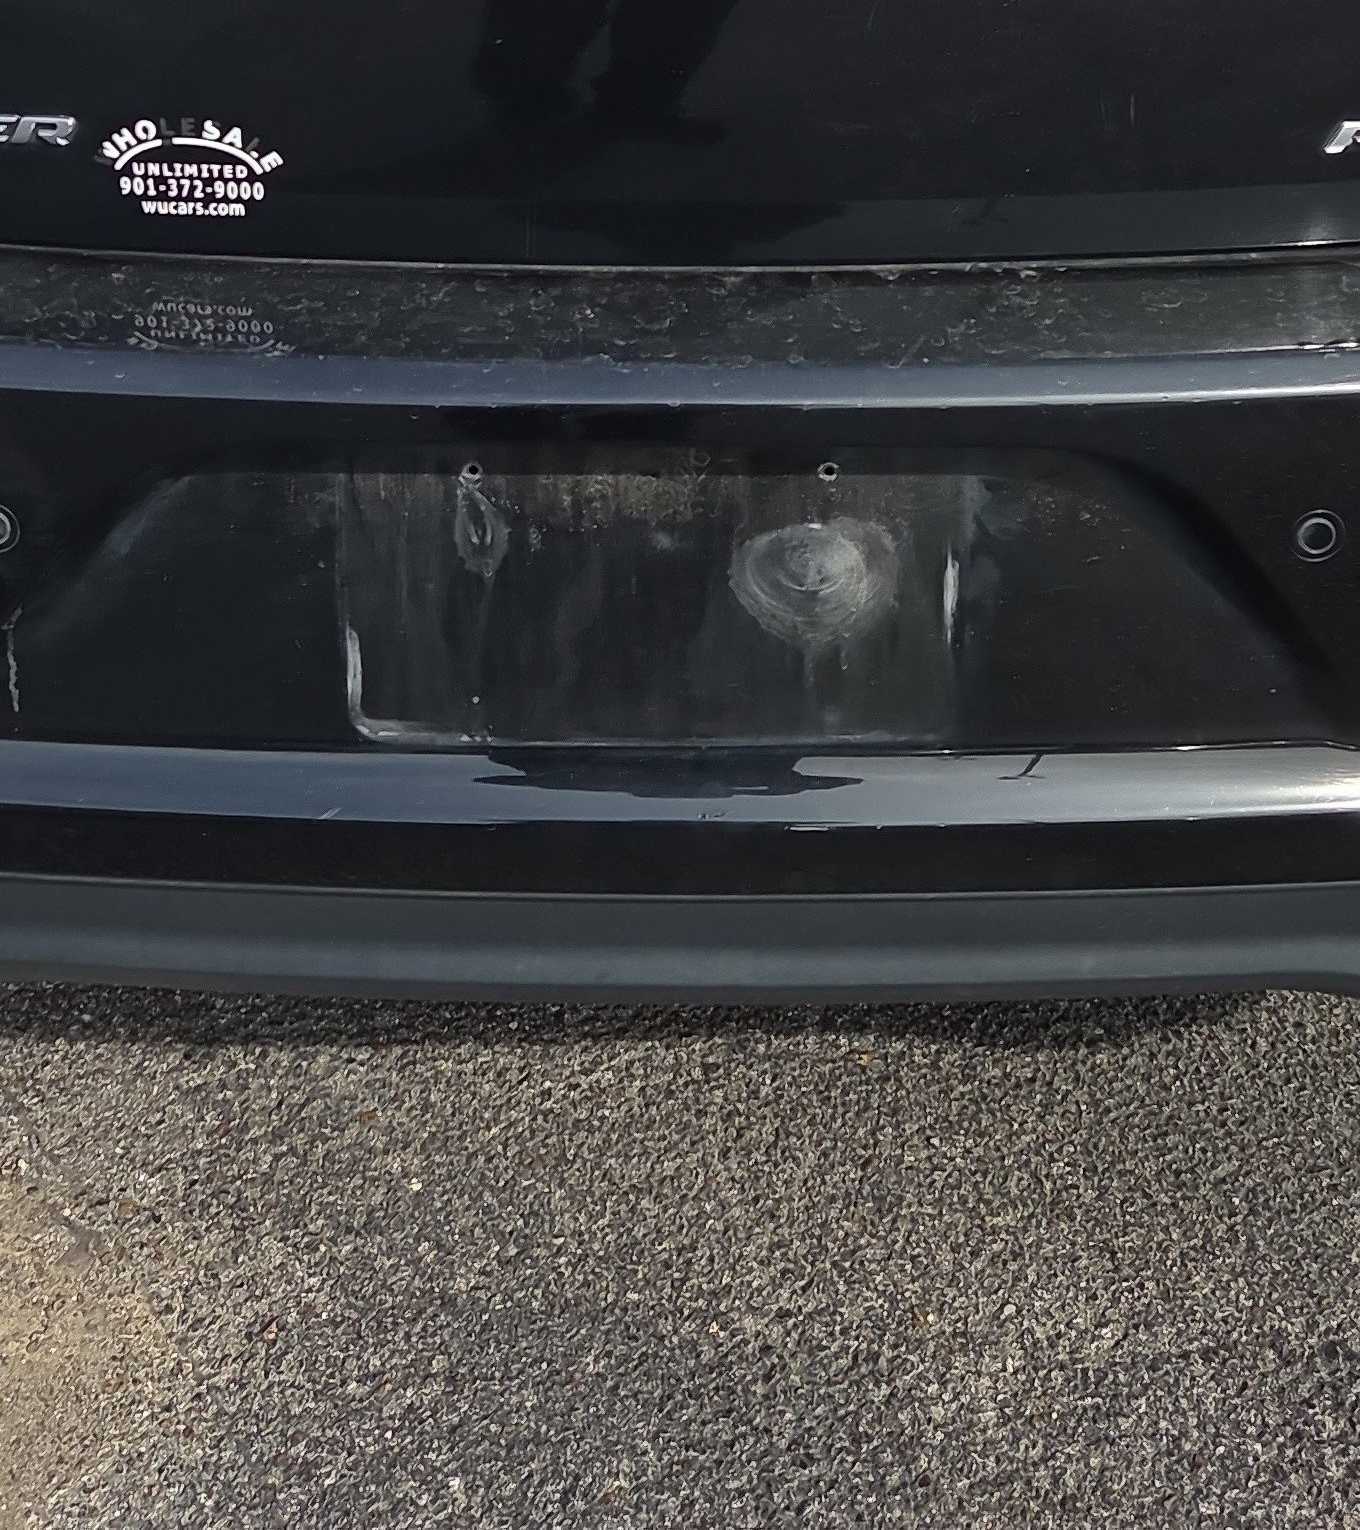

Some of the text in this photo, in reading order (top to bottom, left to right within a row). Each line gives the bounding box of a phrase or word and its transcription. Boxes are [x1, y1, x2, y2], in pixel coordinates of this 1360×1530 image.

[131, 161, 248, 179] UNLIMITED
[119, 175, 266, 201] 901-372-9000
[140, 200, 247, 217] wucars.com
